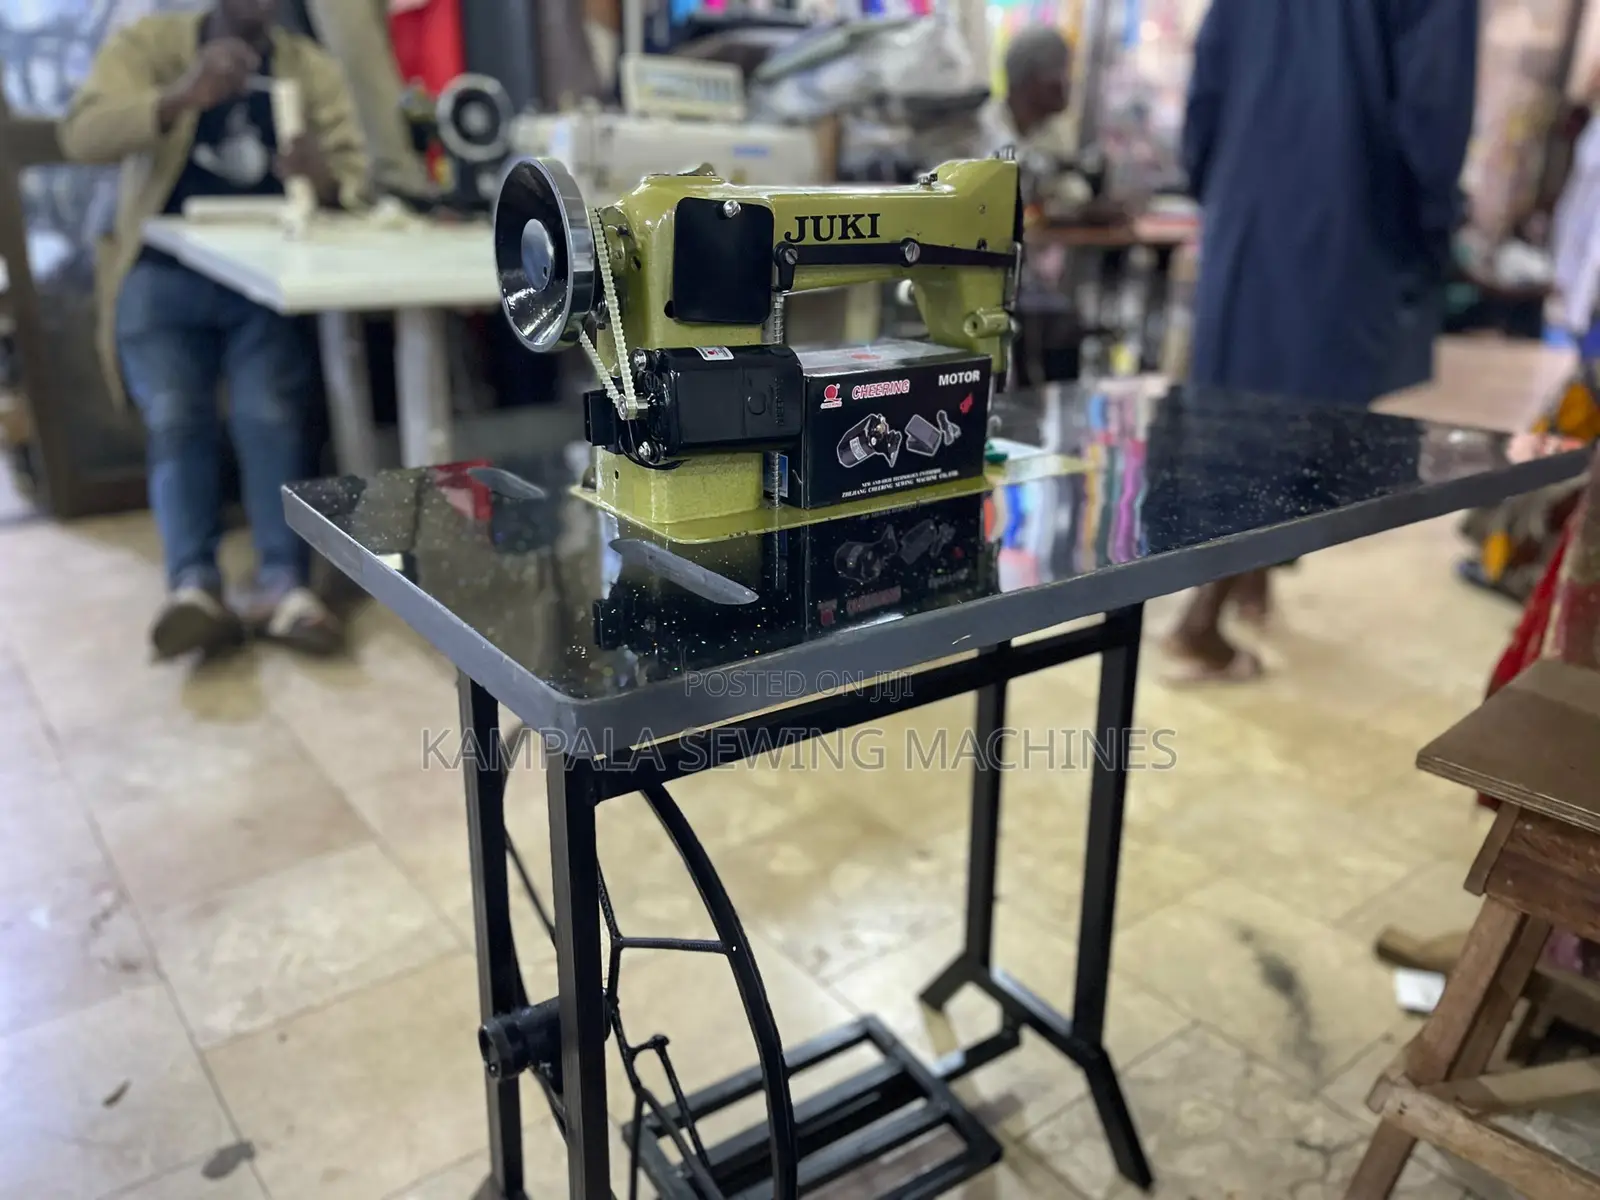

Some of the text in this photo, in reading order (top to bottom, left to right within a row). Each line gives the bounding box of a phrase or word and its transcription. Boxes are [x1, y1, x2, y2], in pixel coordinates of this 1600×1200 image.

[784, 213, 880, 243] JUKI
[938, 370, 981, 386] MOTOR
[852, 379, 910, 400] CHEERING
